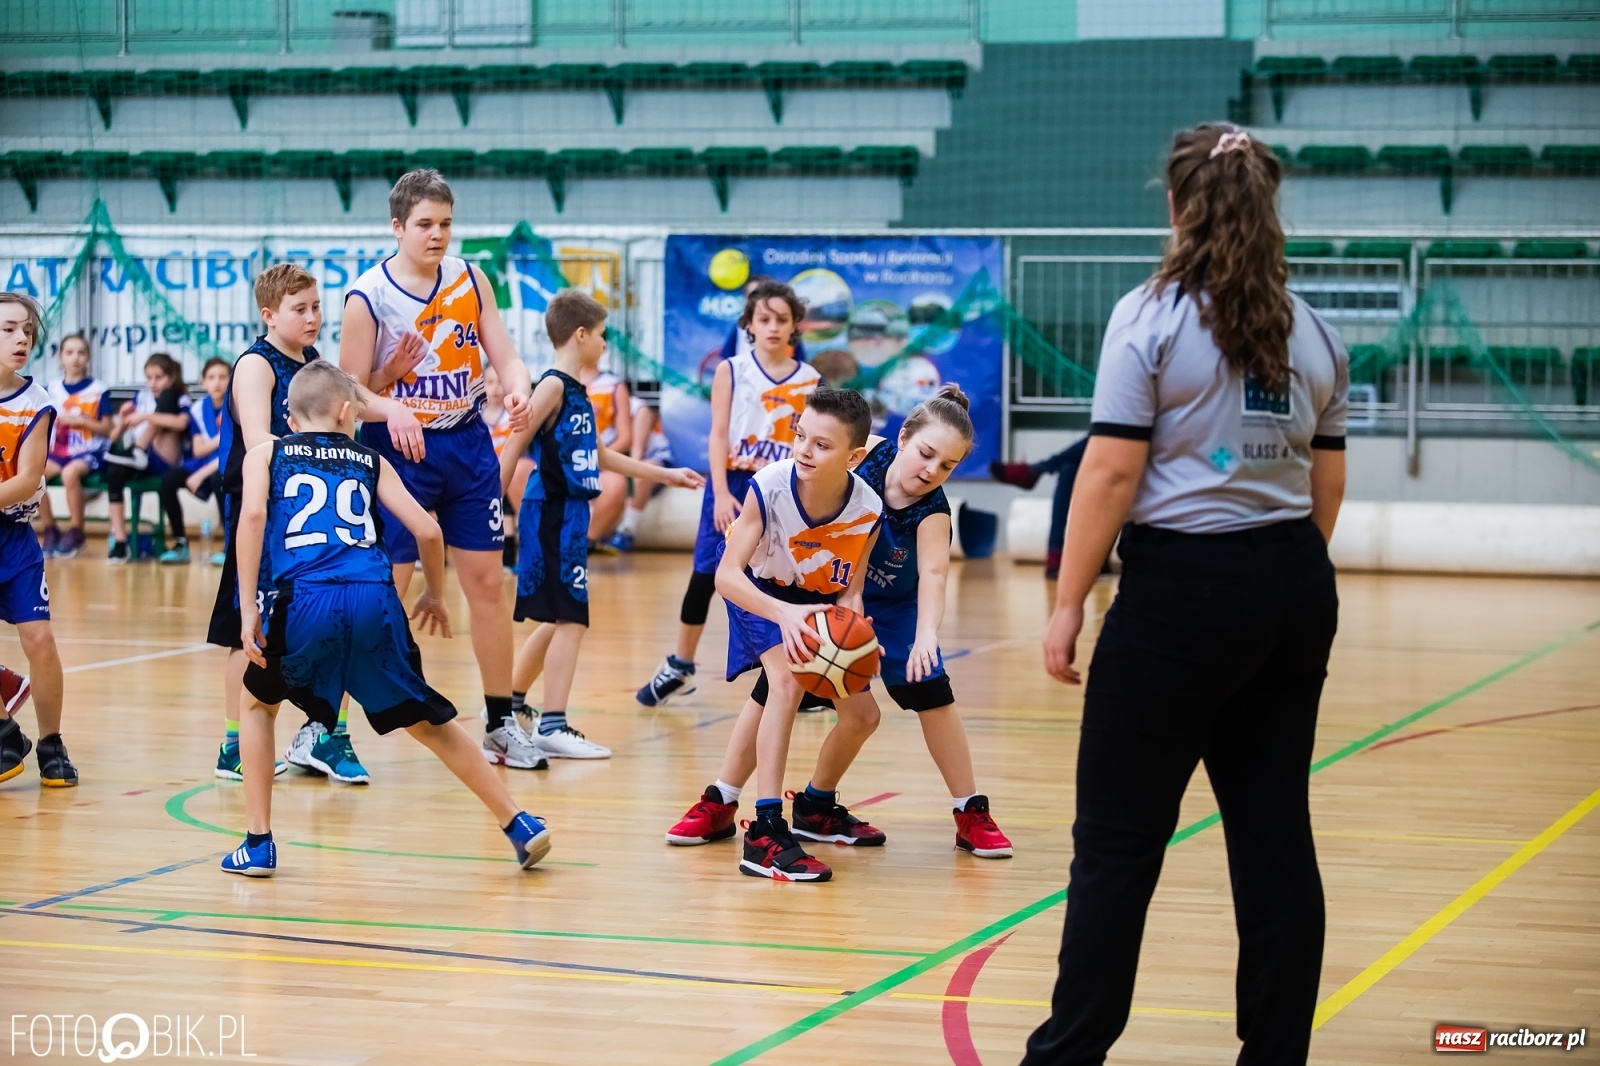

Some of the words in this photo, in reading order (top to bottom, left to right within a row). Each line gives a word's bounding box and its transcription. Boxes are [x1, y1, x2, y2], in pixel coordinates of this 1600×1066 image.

[453, 322, 478, 349] 34
[395, 371, 470, 400] MINI
[394, 397, 471, 411] ASKETBALL
[569, 412, 592, 435] 25
[284, 444, 313, 457] UKS
[314, 446, 374, 469] JEDYNKA
[282, 472, 378, 550] 29
[830, 558, 852, 587] 11
